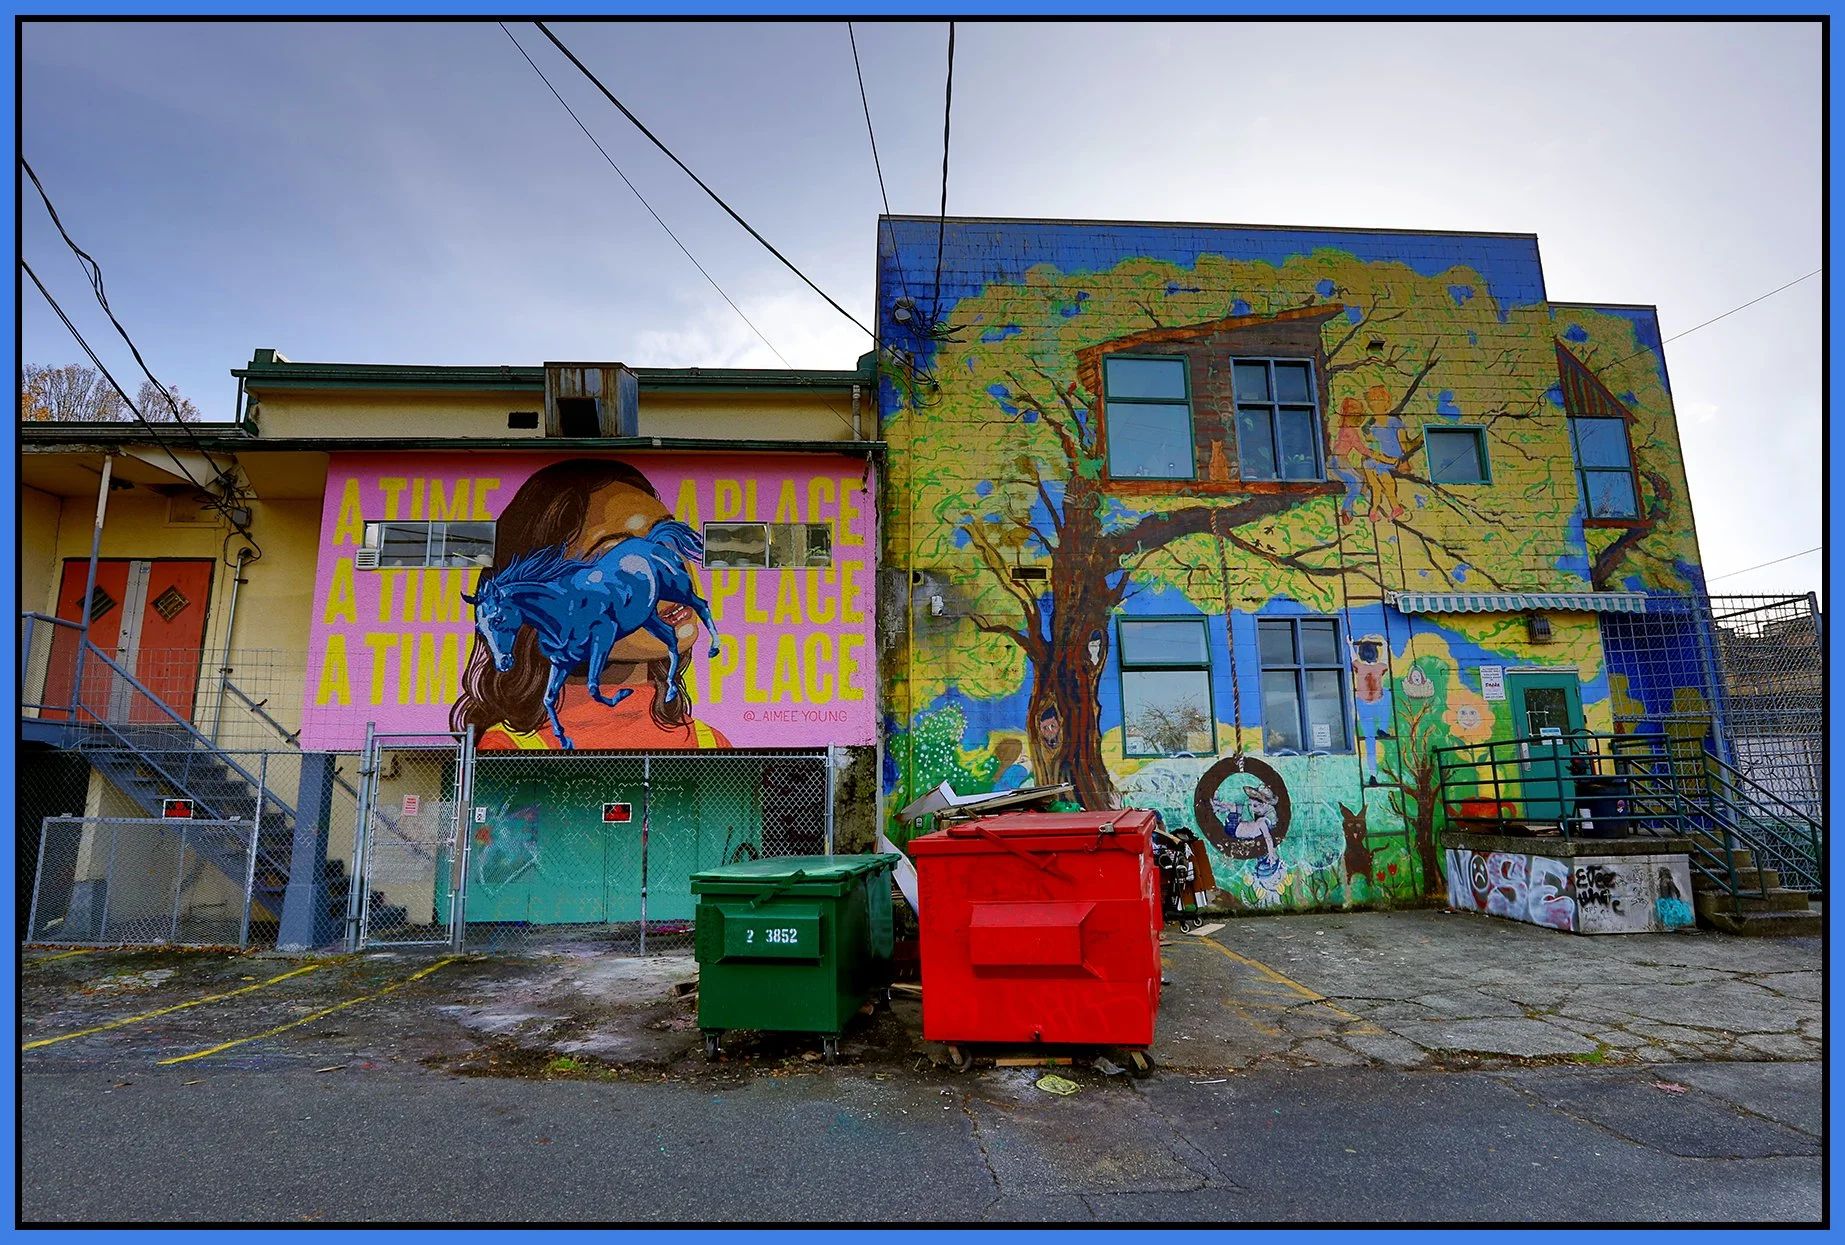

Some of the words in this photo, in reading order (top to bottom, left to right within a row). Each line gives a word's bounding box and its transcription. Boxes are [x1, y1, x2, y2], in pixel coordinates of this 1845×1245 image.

[332, 478, 363, 545] A
[378, 477, 500, 521] TIME
[714, 476, 865, 546] PLACE
[323, 557, 357, 624] A
[711, 560, 866, 624] PLACE
[315, 633, 352, 705] A
[365, 632, 475, 705] TIM
[709, 631, 866, 705] PLACE
[746, 929, 754, 943] 2
[765, 928, 798, 943] 3852
